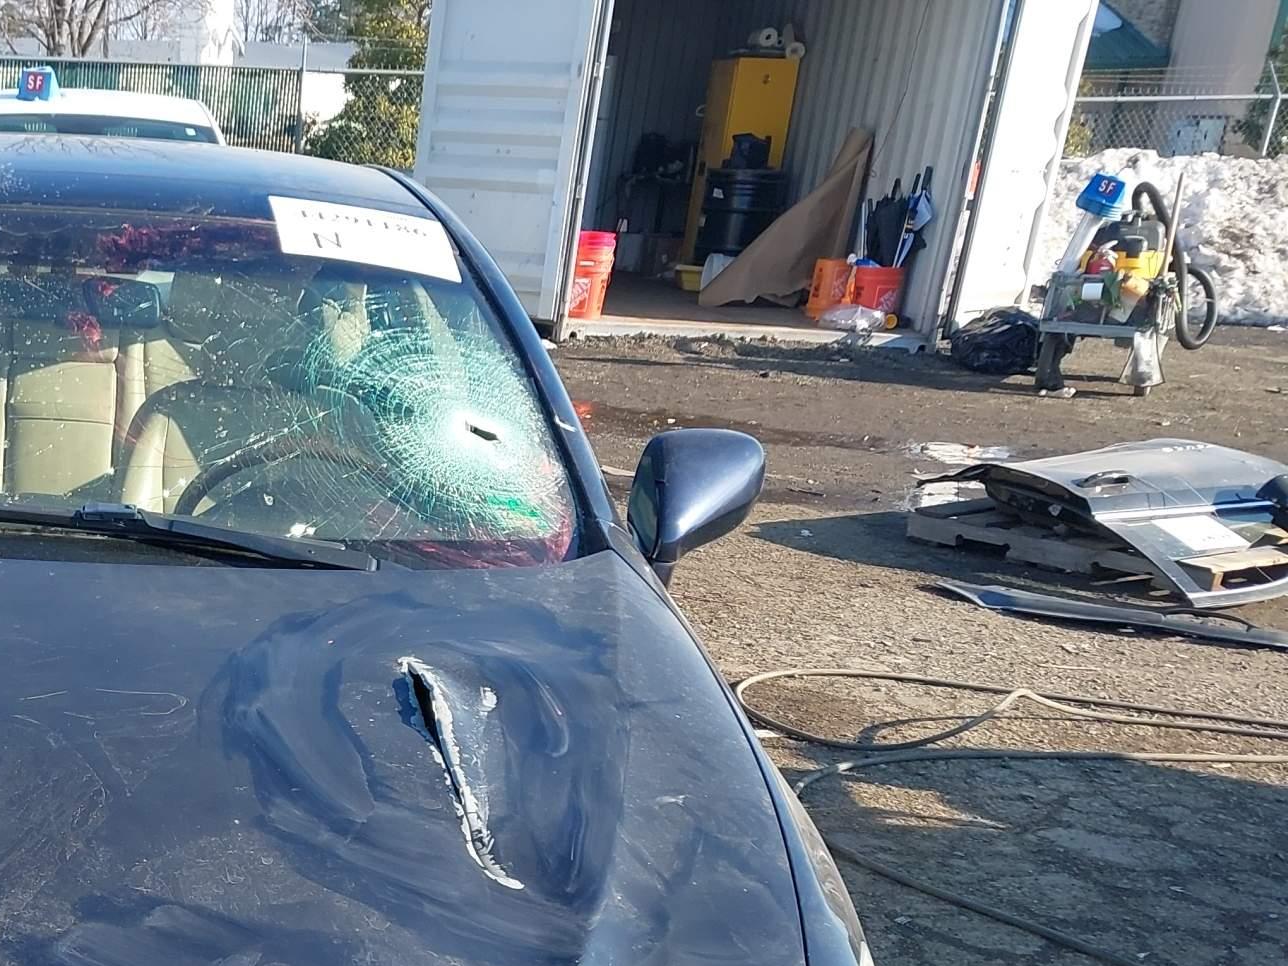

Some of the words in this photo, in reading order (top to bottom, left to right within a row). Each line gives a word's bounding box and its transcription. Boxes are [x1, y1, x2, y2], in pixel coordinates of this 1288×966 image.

[27, 74, 43, 90] SF
[1098, 179, 1116, 193] SF
[312, 231, 343, 249] N
